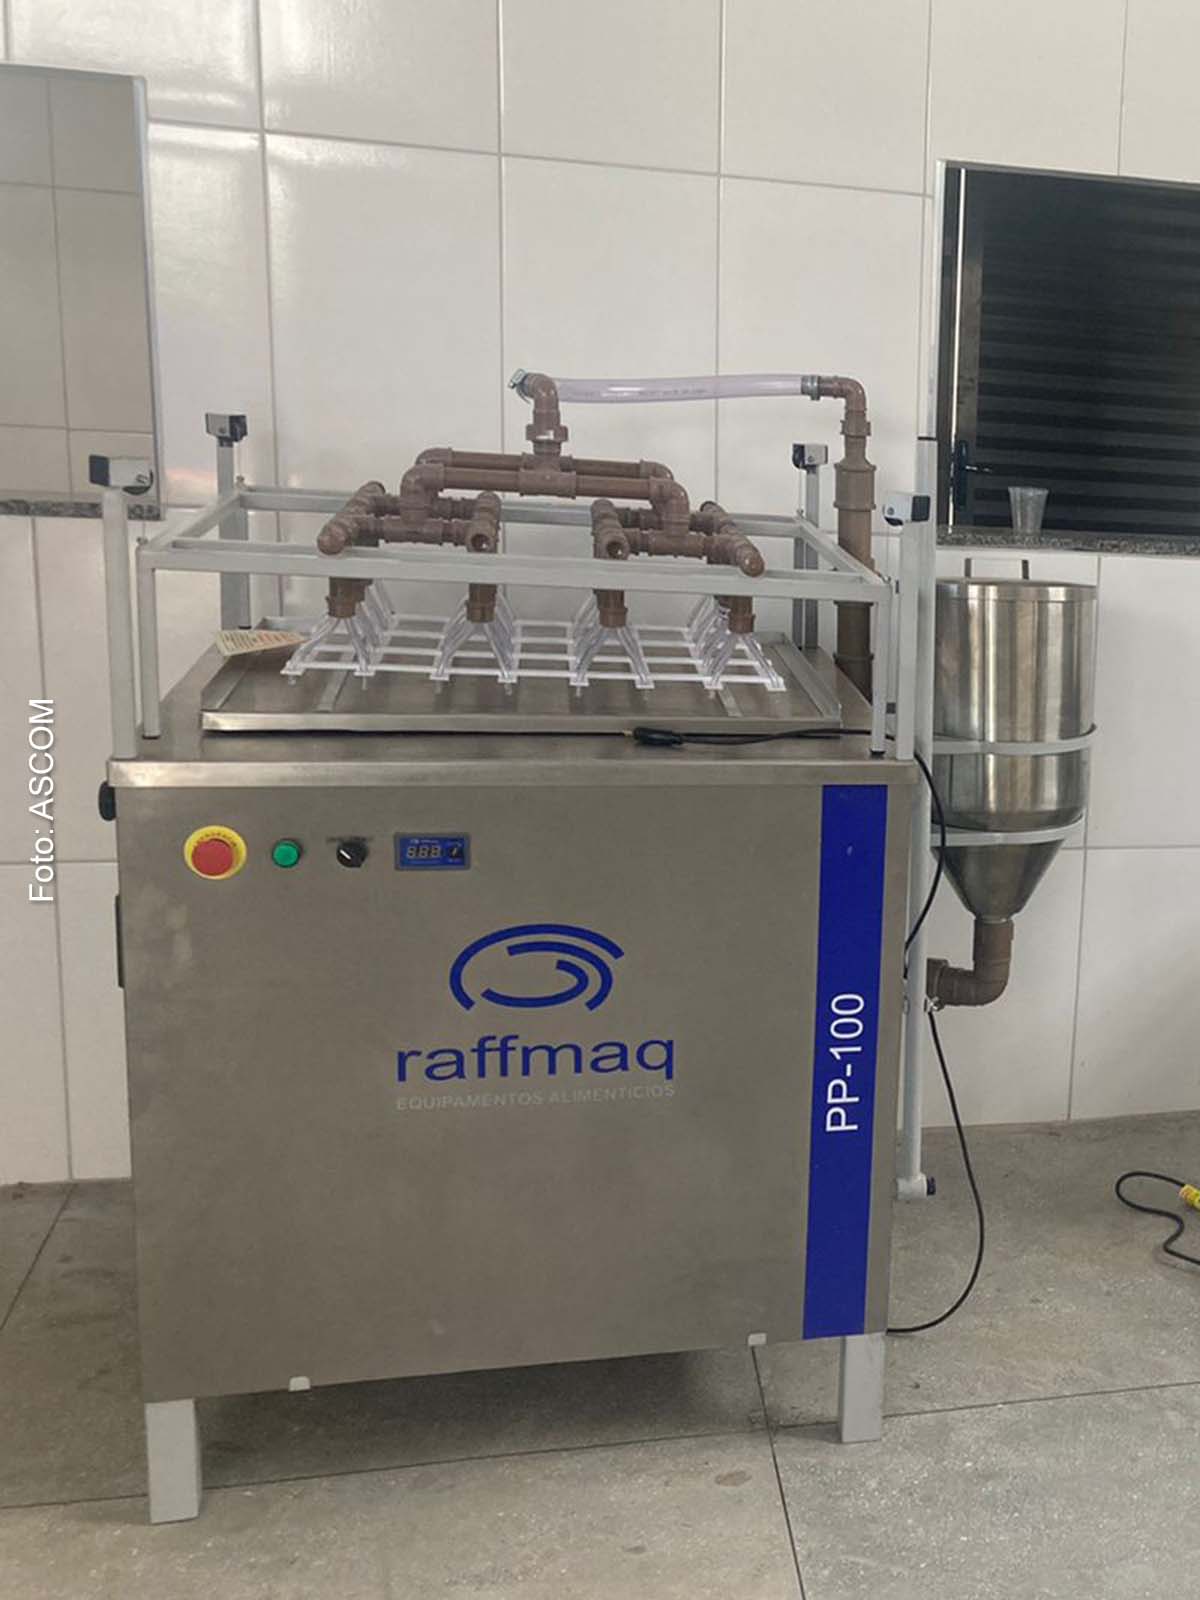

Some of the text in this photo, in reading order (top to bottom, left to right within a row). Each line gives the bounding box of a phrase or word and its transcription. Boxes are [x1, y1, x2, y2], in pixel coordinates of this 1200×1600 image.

[397, 1034, 675, 1081] raffmaq
[825, 993, 865, 1132] PP-100
[396, 1092, 544, 1111] EQUIPAMENTOS
